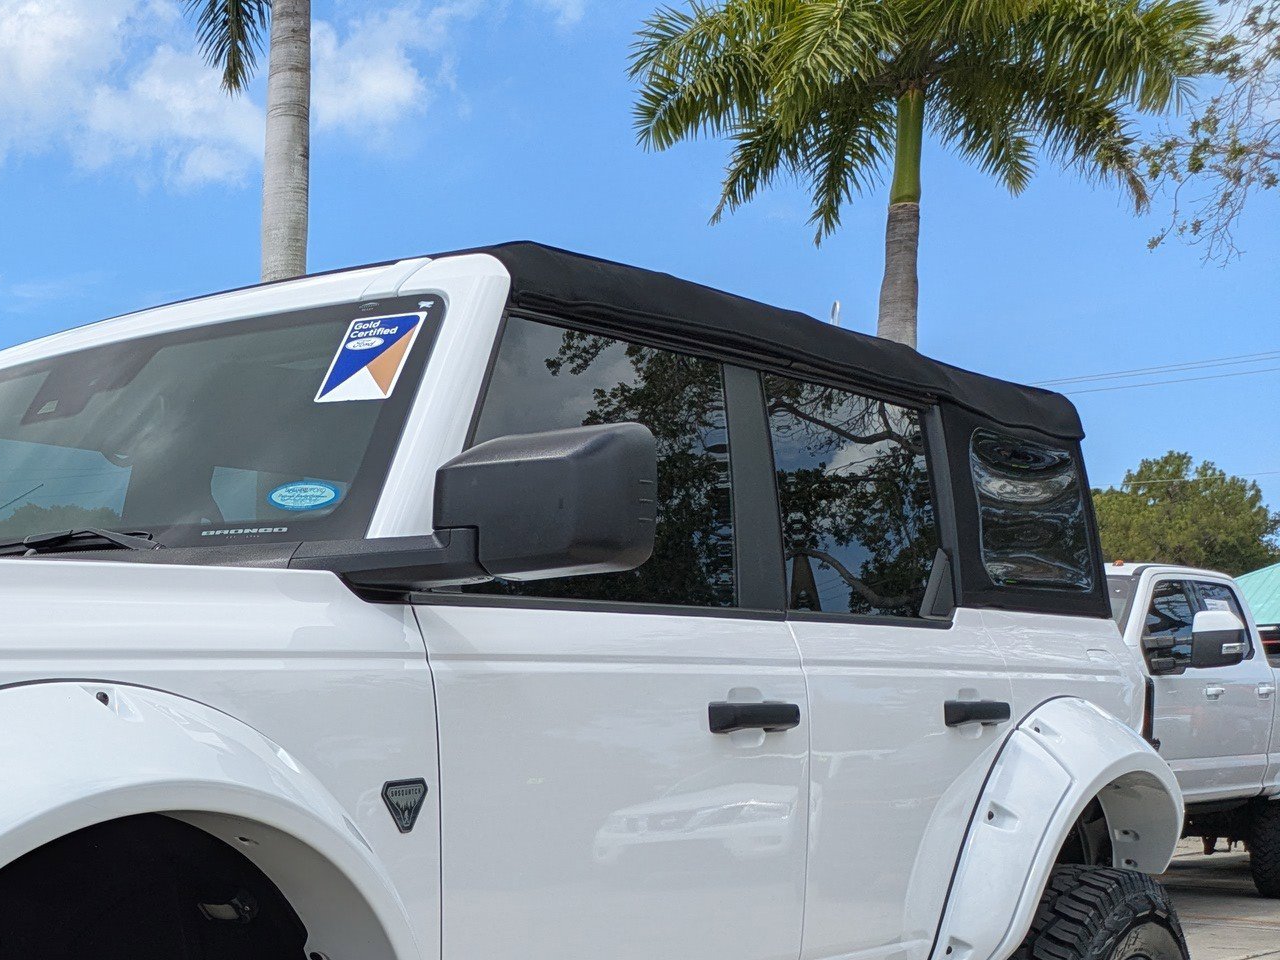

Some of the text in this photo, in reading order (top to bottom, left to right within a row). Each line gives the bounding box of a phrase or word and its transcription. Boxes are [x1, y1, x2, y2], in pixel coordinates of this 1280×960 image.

[353, 320, 382, 331] Gold
[350, 326, 399, 339] Certified
[201, 527, 288, 536] BRONCO
[390, 788, 421, 798] SASQUATCH
